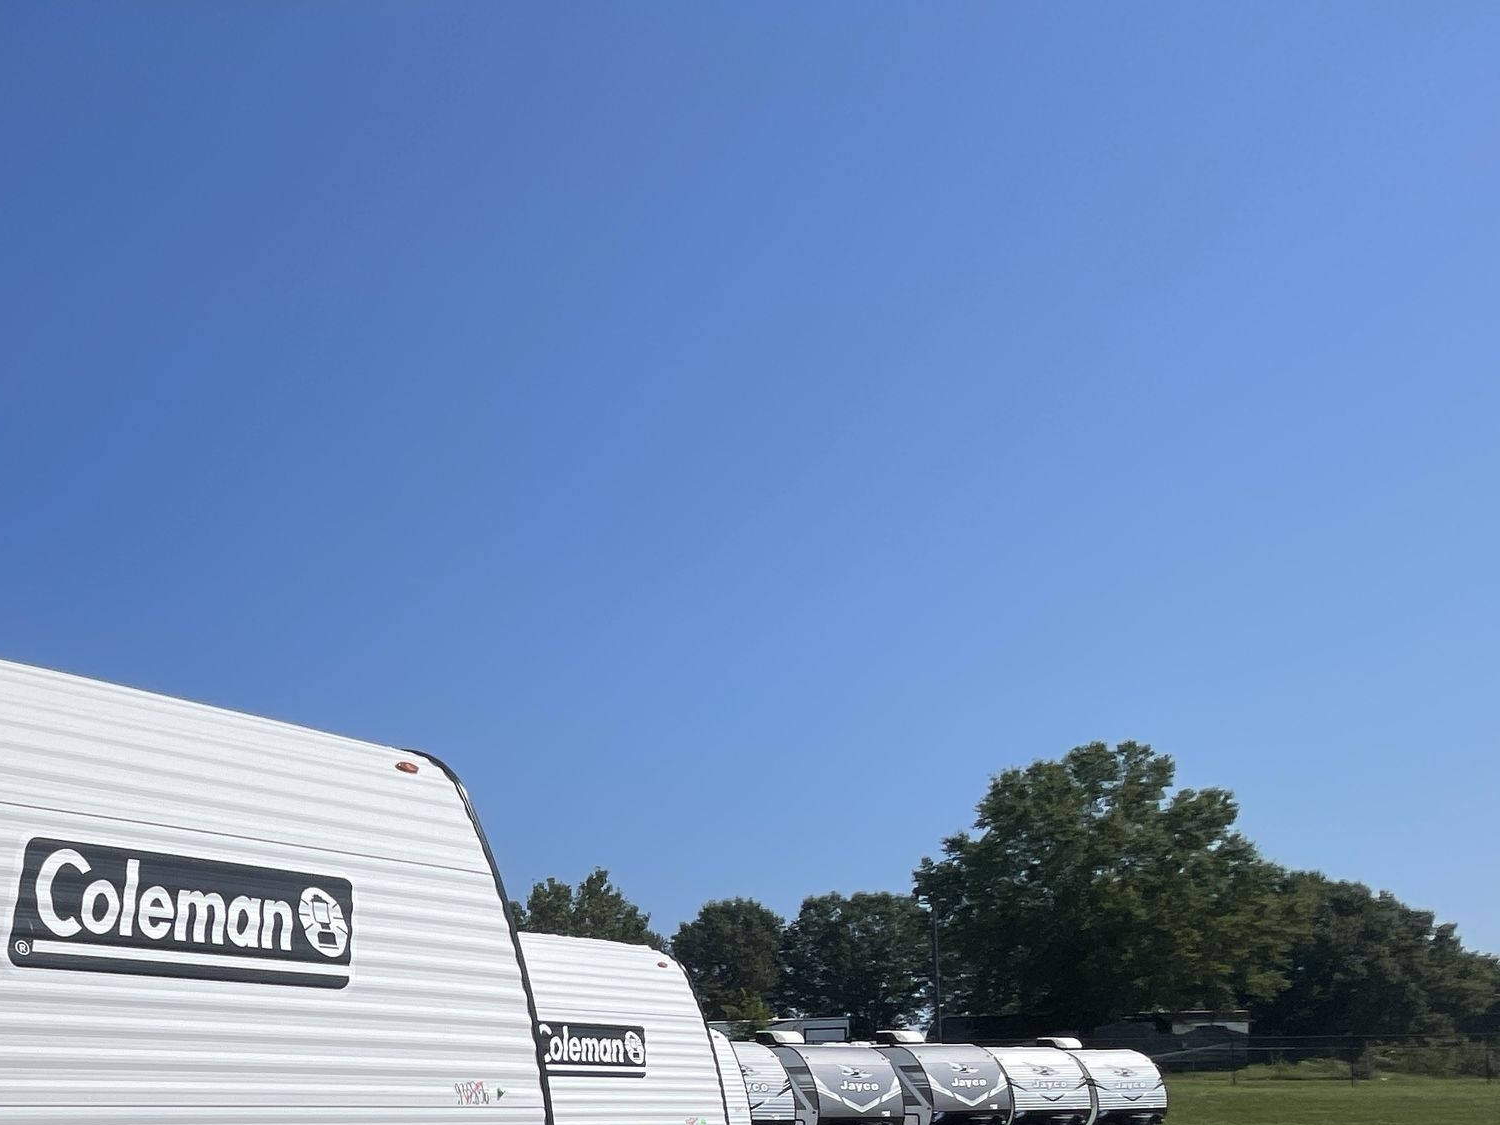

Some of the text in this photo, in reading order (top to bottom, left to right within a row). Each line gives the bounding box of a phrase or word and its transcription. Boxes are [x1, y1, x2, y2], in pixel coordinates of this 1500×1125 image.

[35, 848, 293, 951] Coleman
[747, 1082, 769, 1093] yco
[840, 1080, 879, 1092] Jayco
[951, 1077, 987, 1088] Jayco
[1033, 1079, 1068, 1090] Jayco
